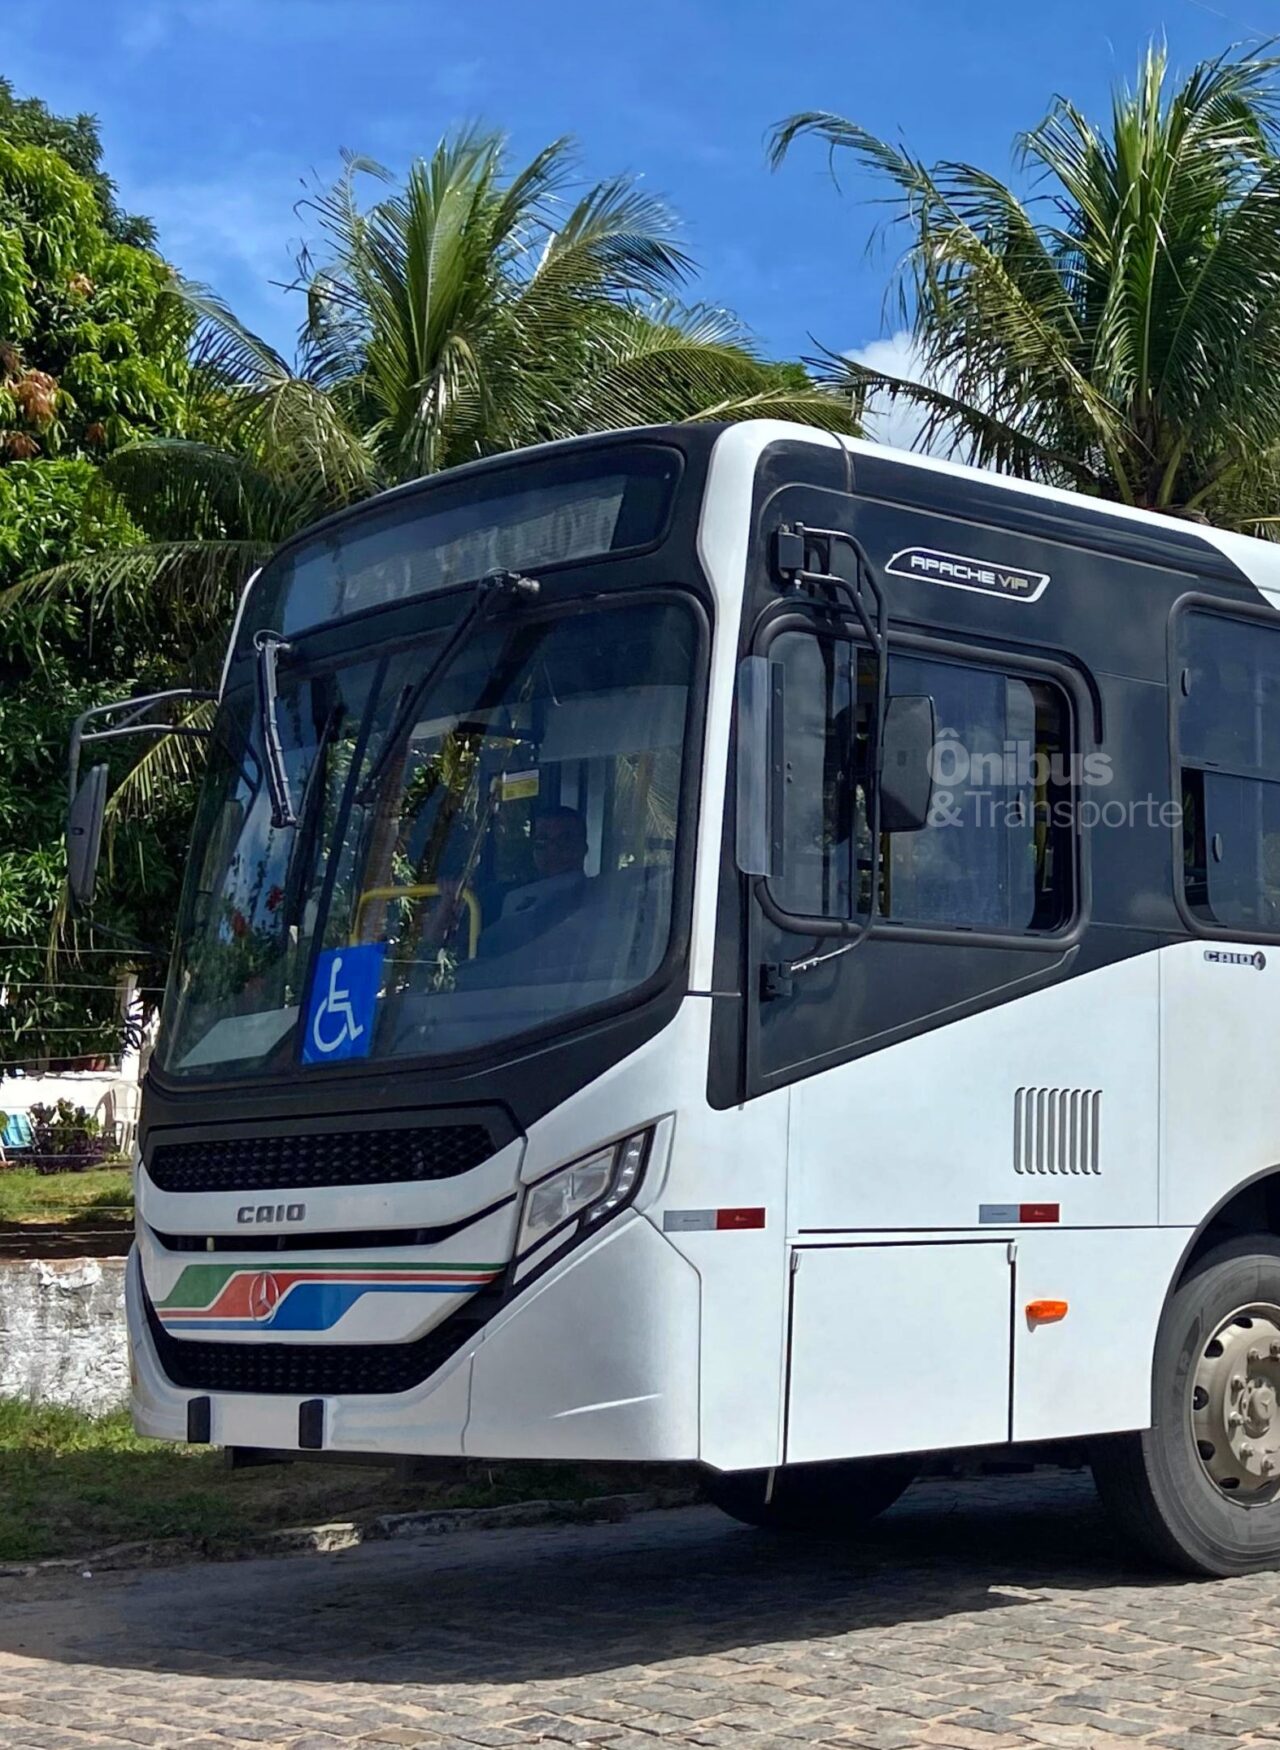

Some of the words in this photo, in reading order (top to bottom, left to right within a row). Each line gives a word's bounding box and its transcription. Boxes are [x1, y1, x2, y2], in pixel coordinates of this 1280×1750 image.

[911, 555, 996, 585] APACHE
[999, 573, 1029, 590] VIP
[1203, 950, 1255, 965] CAIO
[237, 1203, 306, 1224] CAIO
